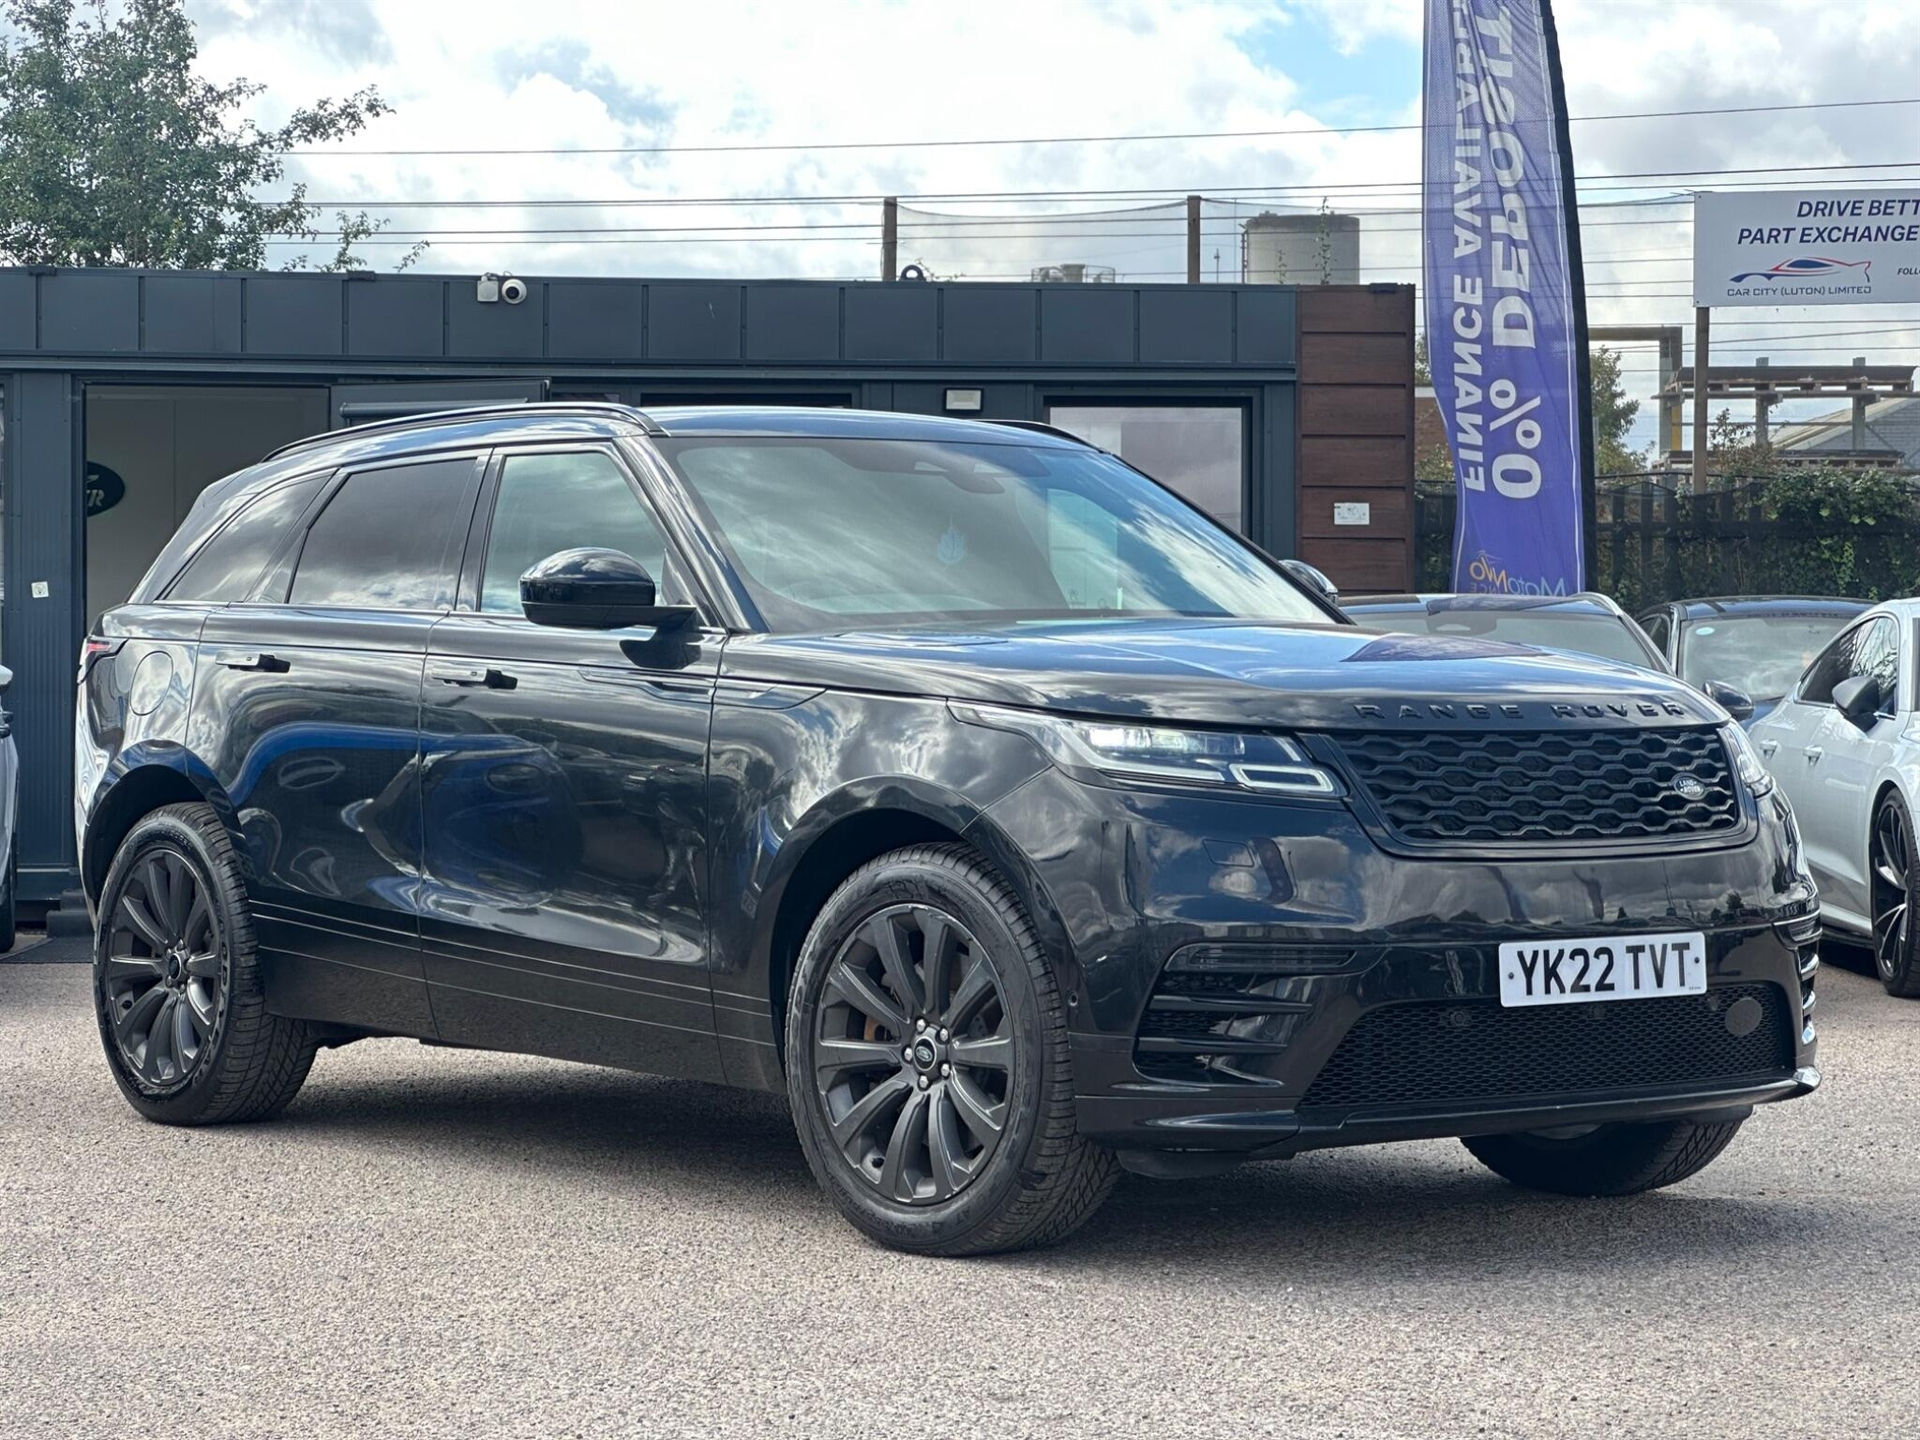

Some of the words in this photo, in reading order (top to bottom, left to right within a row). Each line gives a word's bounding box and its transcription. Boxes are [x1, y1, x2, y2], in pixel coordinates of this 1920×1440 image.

[1796, 199, 1864, 218] DRIVE
[1737, 227, 1796, 245] PART
[1799, 225, 1920, 244] EXCHANGE
[1897, 267, 1920, 275] FOLL
[1727, 288, 1750, 297] CAR
[1753, 287, 1778, 297] CITY
[1780, 286, 1825, 296] (LUTON)
[1828, 285, 1872, 295] LIMITED
[1353, 704, 1525, 720] RANGE
[1550, 701, 1685, 719] ROVER
[1516, 946, 1616, 996] YK22
[1625, 942, 1691, 990] TVT
